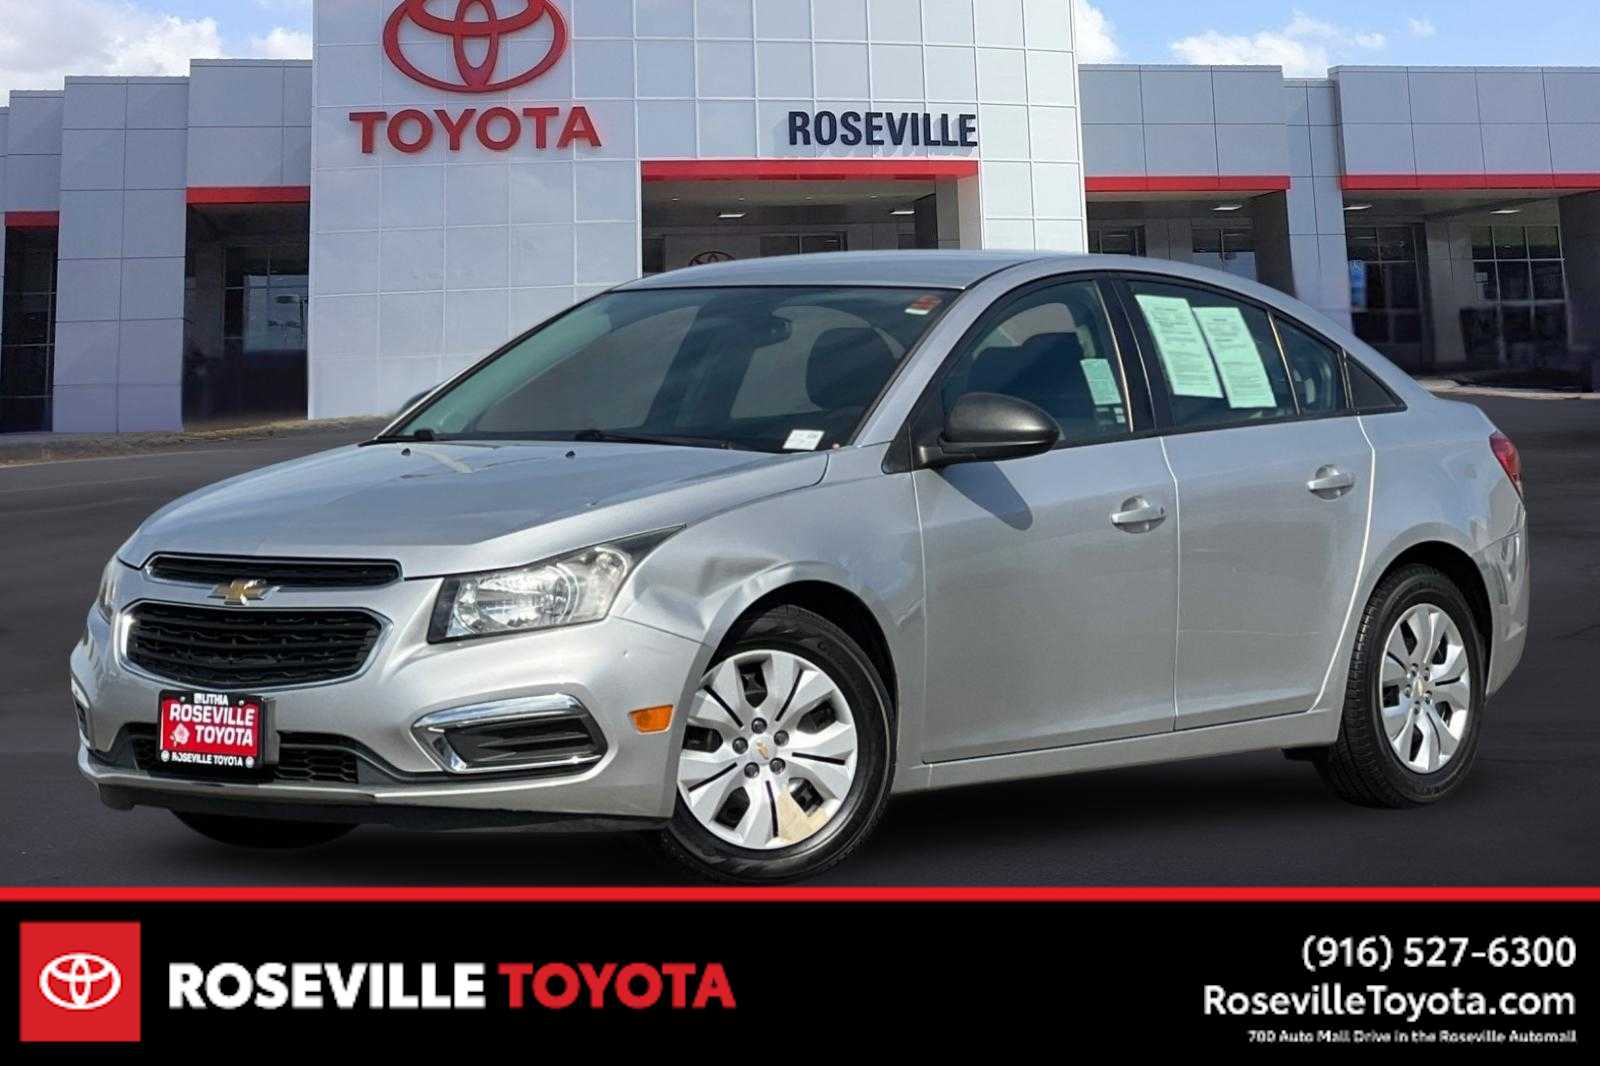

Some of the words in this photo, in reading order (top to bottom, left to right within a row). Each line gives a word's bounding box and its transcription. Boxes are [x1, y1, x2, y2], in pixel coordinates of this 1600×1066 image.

[349, 105, 602, 154] TOYOTA
[788, 110, 978, 147] ROSEVILLE
[169, 703, 255, 726] ROSEVILLE
[194, 725, 253, 746] TOYOTA
